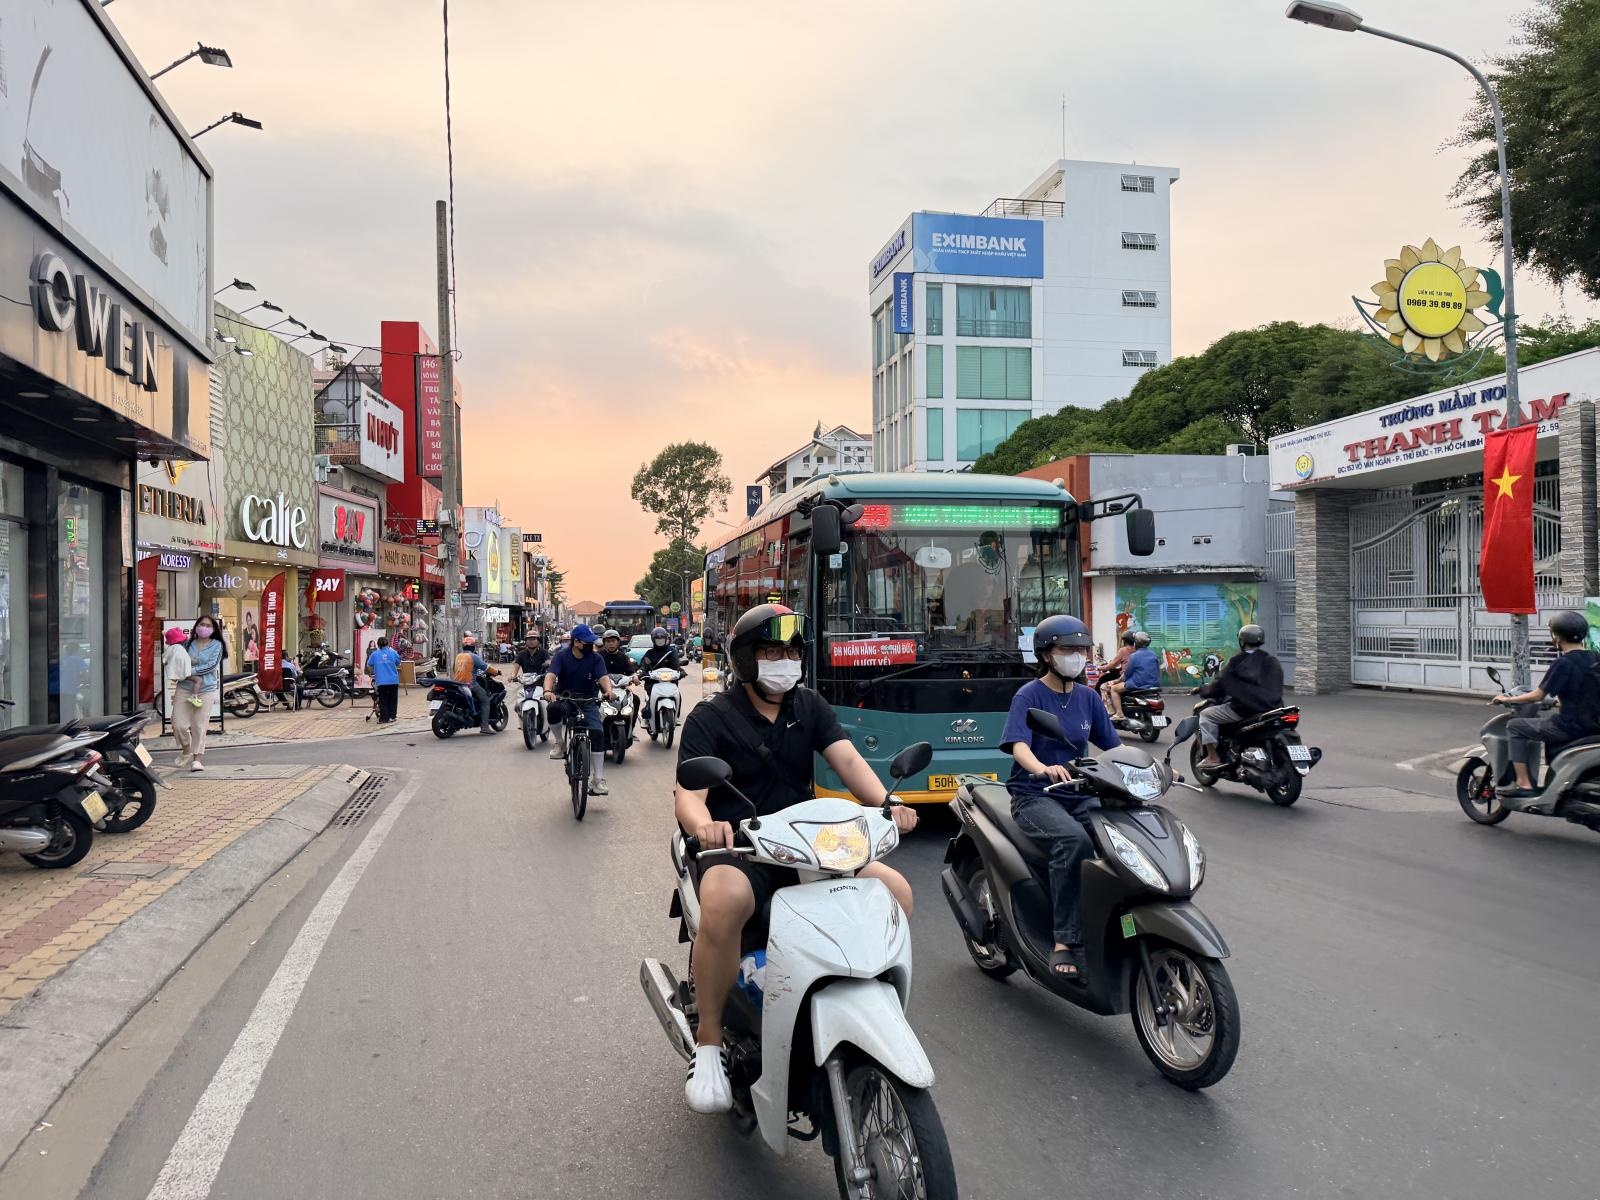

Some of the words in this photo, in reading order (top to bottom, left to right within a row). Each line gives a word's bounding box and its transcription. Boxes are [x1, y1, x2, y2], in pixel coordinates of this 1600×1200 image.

[932, 232, 1026, 252] EXIMBANK
[873, 230, 905, 278] EXIMBANK
[1407, 299, 1462, 310] 0969.39.89.89
[29, 250, 158, 392] OWEN
[430, 396, 440, 404] TÂ
[1379, 403, 1434, 428] TRƯỜNG
[1344, 418, 1463, 462] THANH
[1376, 457, 1391, 466] NGÂN
[1403, 450, 1415, 460] THỦ
[1416, 449, 1428, 458] ĐỨC
[1444, 442, 1454, 452] HỒ
[1467, 438, 1483, 448] MINH
[160, 553, 191, 568] NORESSY
[316, 578, 340, 592] BAY
[268, 592, 276, 611] THAO
[266, 627, 275, 652] TRANG
[844, 645, 859, 655] NGÂN
[861, 642, 876, 655] HÀNG
[902, 642, 914, 654] ĐỨC
[830, 885, 858, 893] HONDA
